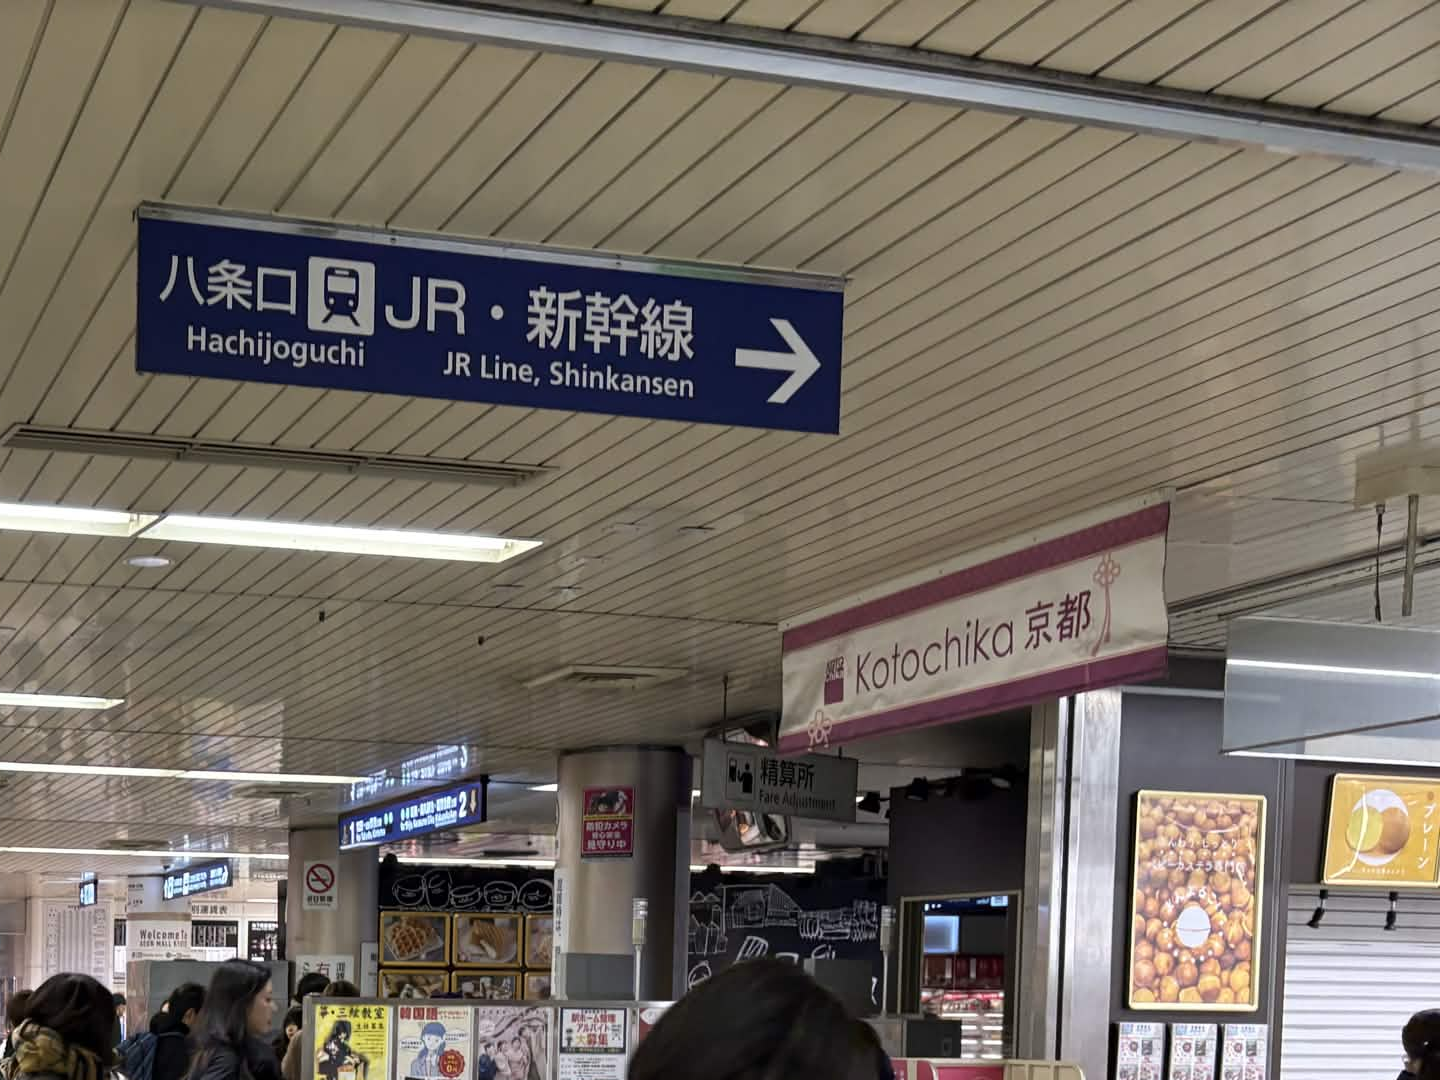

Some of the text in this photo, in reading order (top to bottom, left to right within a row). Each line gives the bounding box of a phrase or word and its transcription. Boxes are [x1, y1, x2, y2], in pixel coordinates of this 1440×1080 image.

[161, 254, 297, 315] 八条口
[187, 326, 365, 368] Hachijoguchi
[444, 351, 694, 398] JR Line, Shinkansen
[855, 590, 1092, 695] Kotochika 京都
[760, 757, 815, 792] 精算所
[459, 791, 467, 818] 2
[576, 1024, 609, 1033] アルバイト
